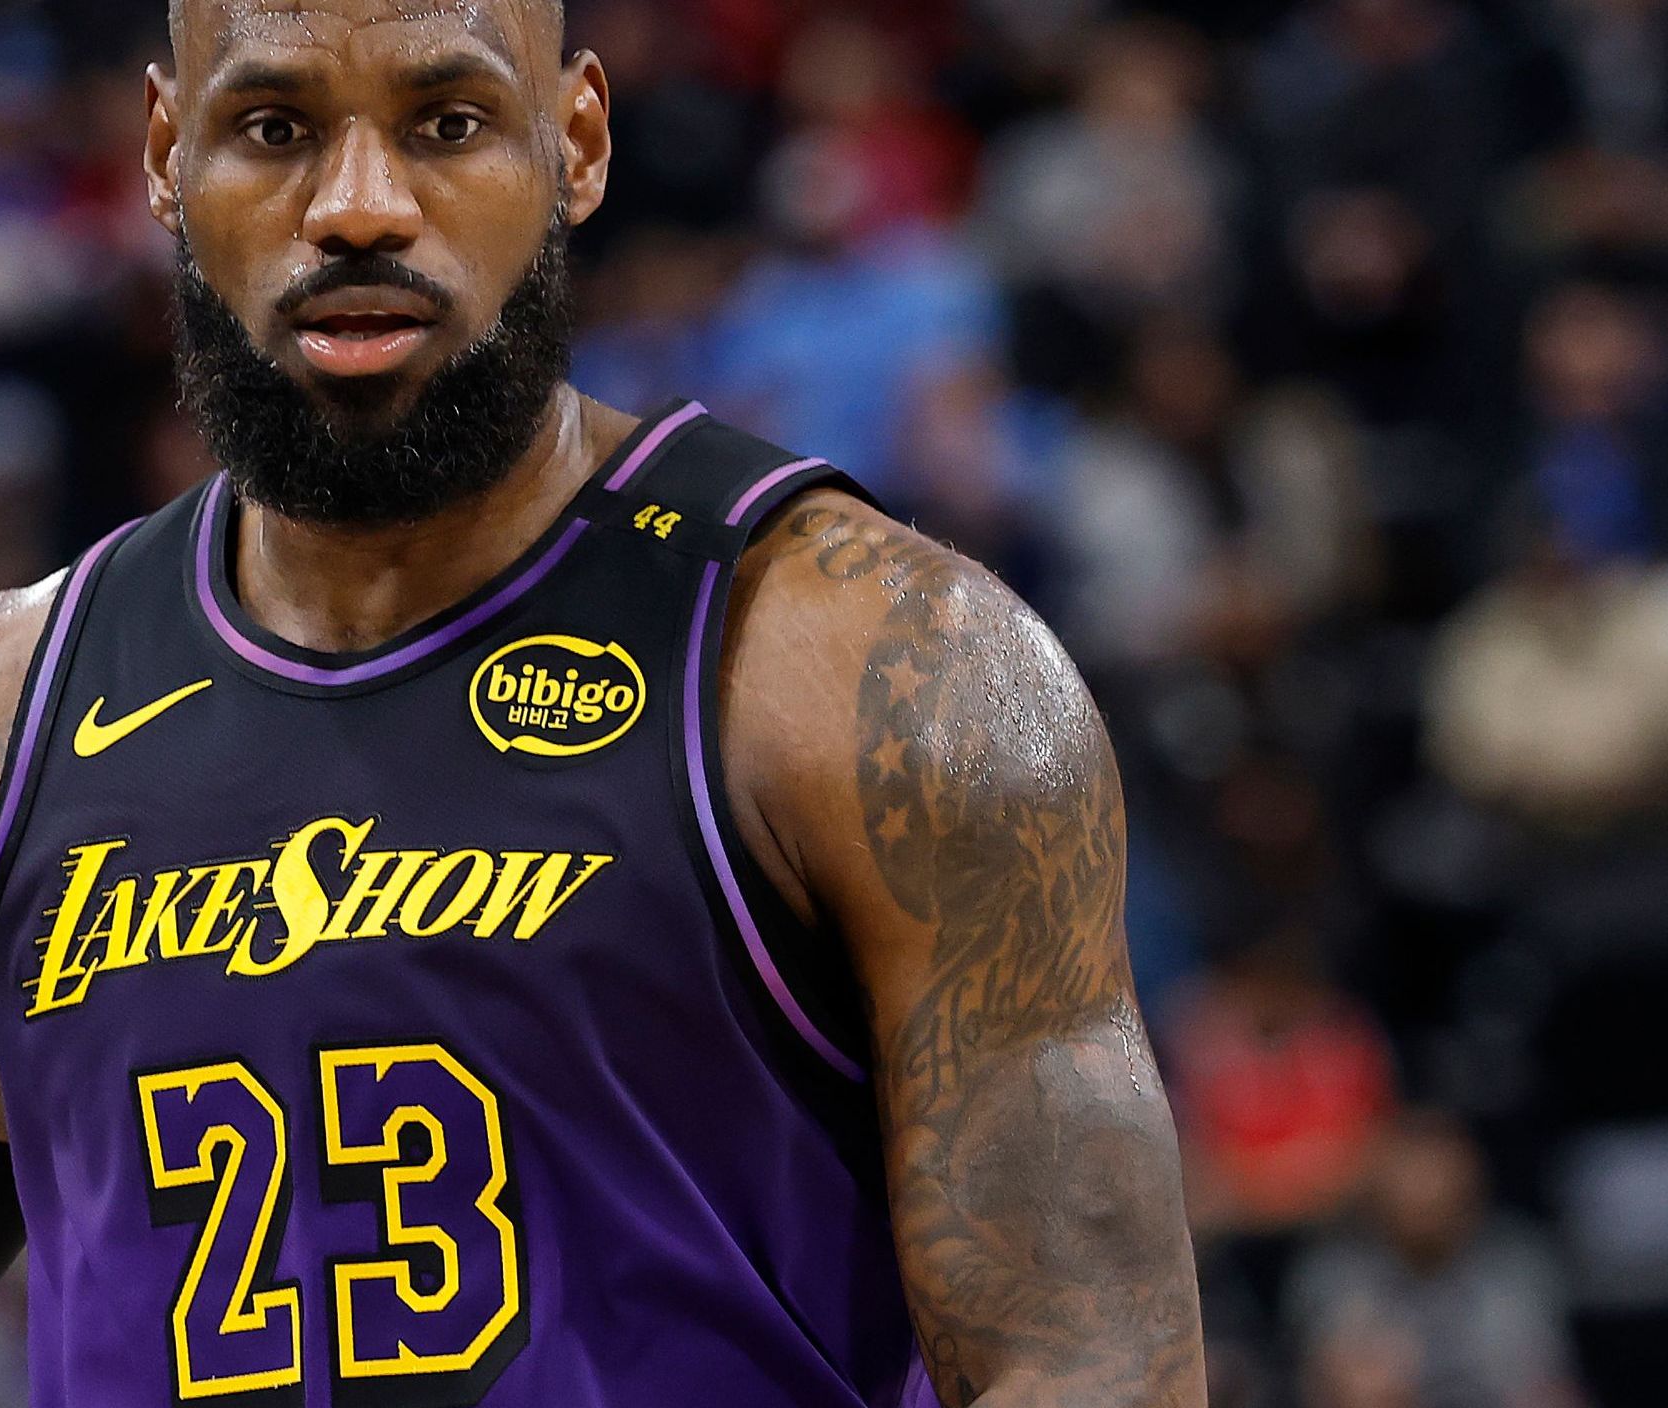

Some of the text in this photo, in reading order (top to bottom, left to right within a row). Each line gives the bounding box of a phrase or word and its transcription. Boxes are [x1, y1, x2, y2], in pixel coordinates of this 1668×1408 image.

[633, 504, 682, 540] 44
[487, 663, 634, 723] bibigo
[508, 704, 569, 729] 비비고
[136, 1041, 522, 1402] 23
